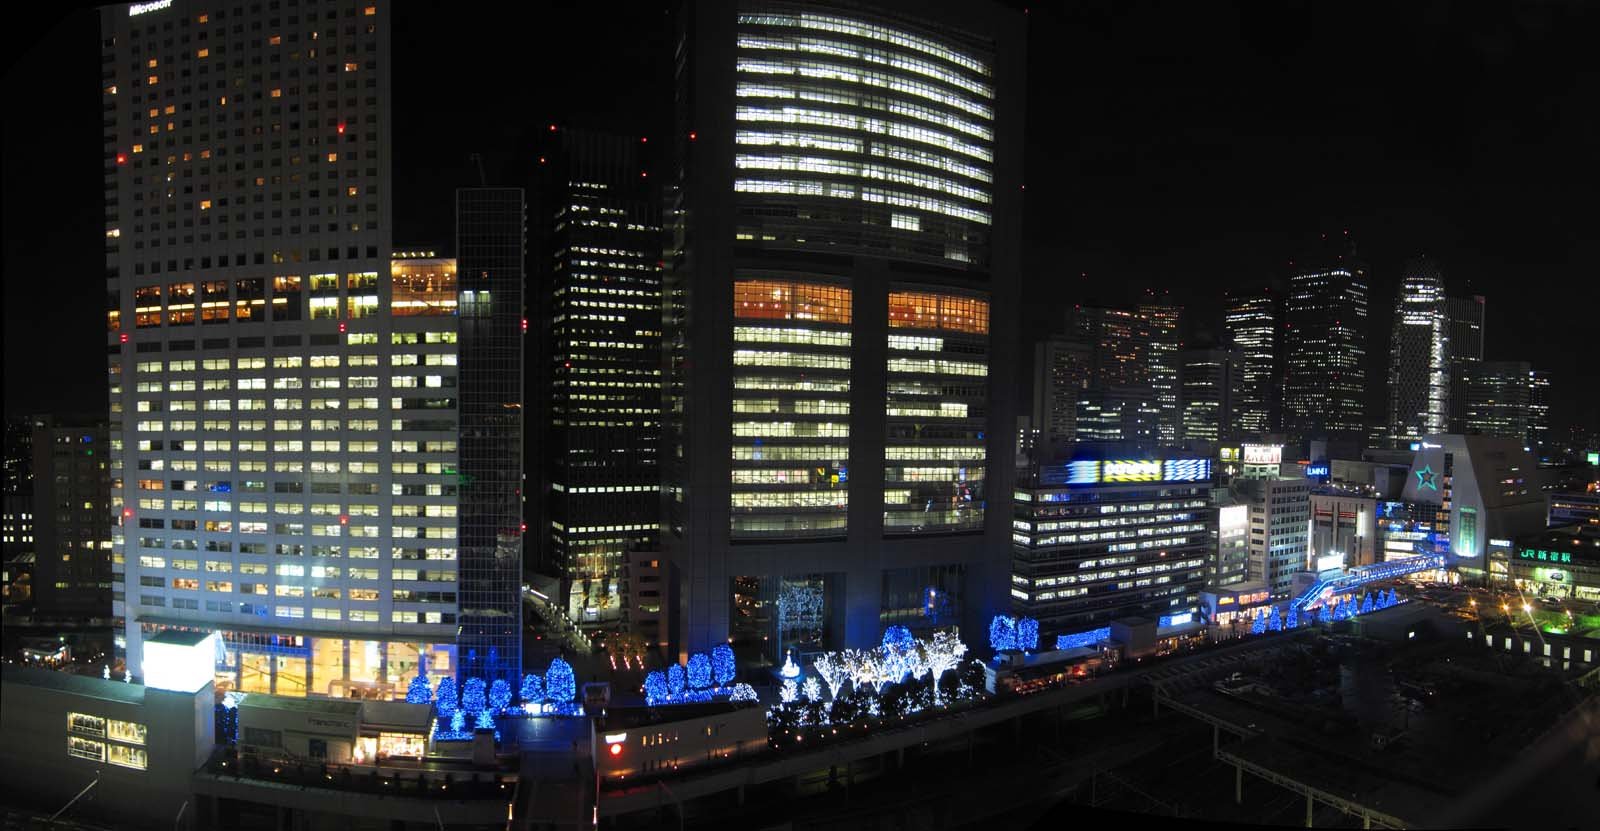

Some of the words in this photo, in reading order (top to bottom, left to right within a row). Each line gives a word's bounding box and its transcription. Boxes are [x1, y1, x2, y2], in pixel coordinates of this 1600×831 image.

[129, 0, 172, 16] Microsoft
[1520, 549, 1535, 559] JR
[1537, 550, 1571, 563] 新宿駅
